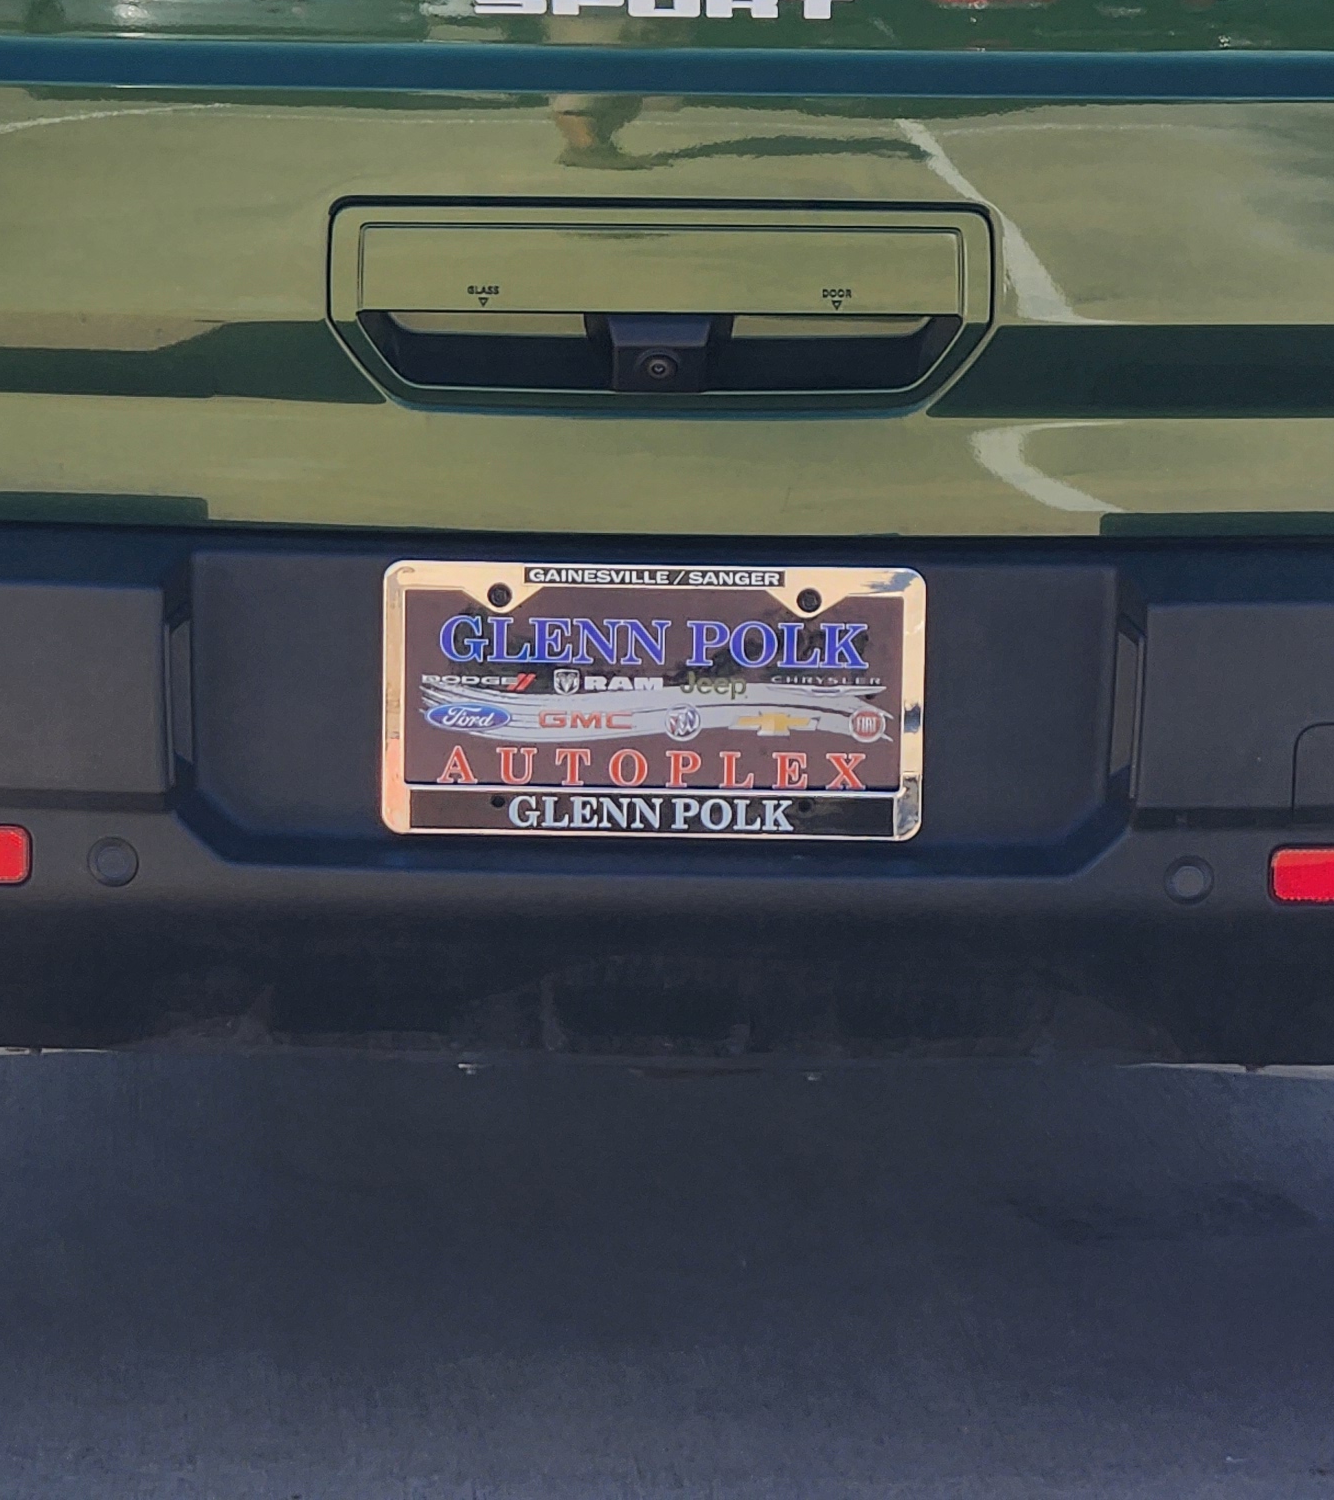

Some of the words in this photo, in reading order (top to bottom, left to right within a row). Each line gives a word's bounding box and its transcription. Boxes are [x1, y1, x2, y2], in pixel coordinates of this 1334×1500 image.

[688, 572, 780, 588] SANGER
[439, 615, 671, 666] GLENN
[686, 620, 869, 669] POLK
[422, 674, 518, 685] DODGE
[584, 676, 664, 691] RAM
[679, 671, 747, 699] Jeep
[770, 676, 882, 685] CHRYSLER
[442, 706, 495, 728] Ford
[539, 709, 633, 730] GMC
[856, 716, 878, 733] FIAT
[437, 746, 867, 790] AUTOPLEX
[508, 795, 662, 829] GLENN
[670, 798, 794, 832] POLK
